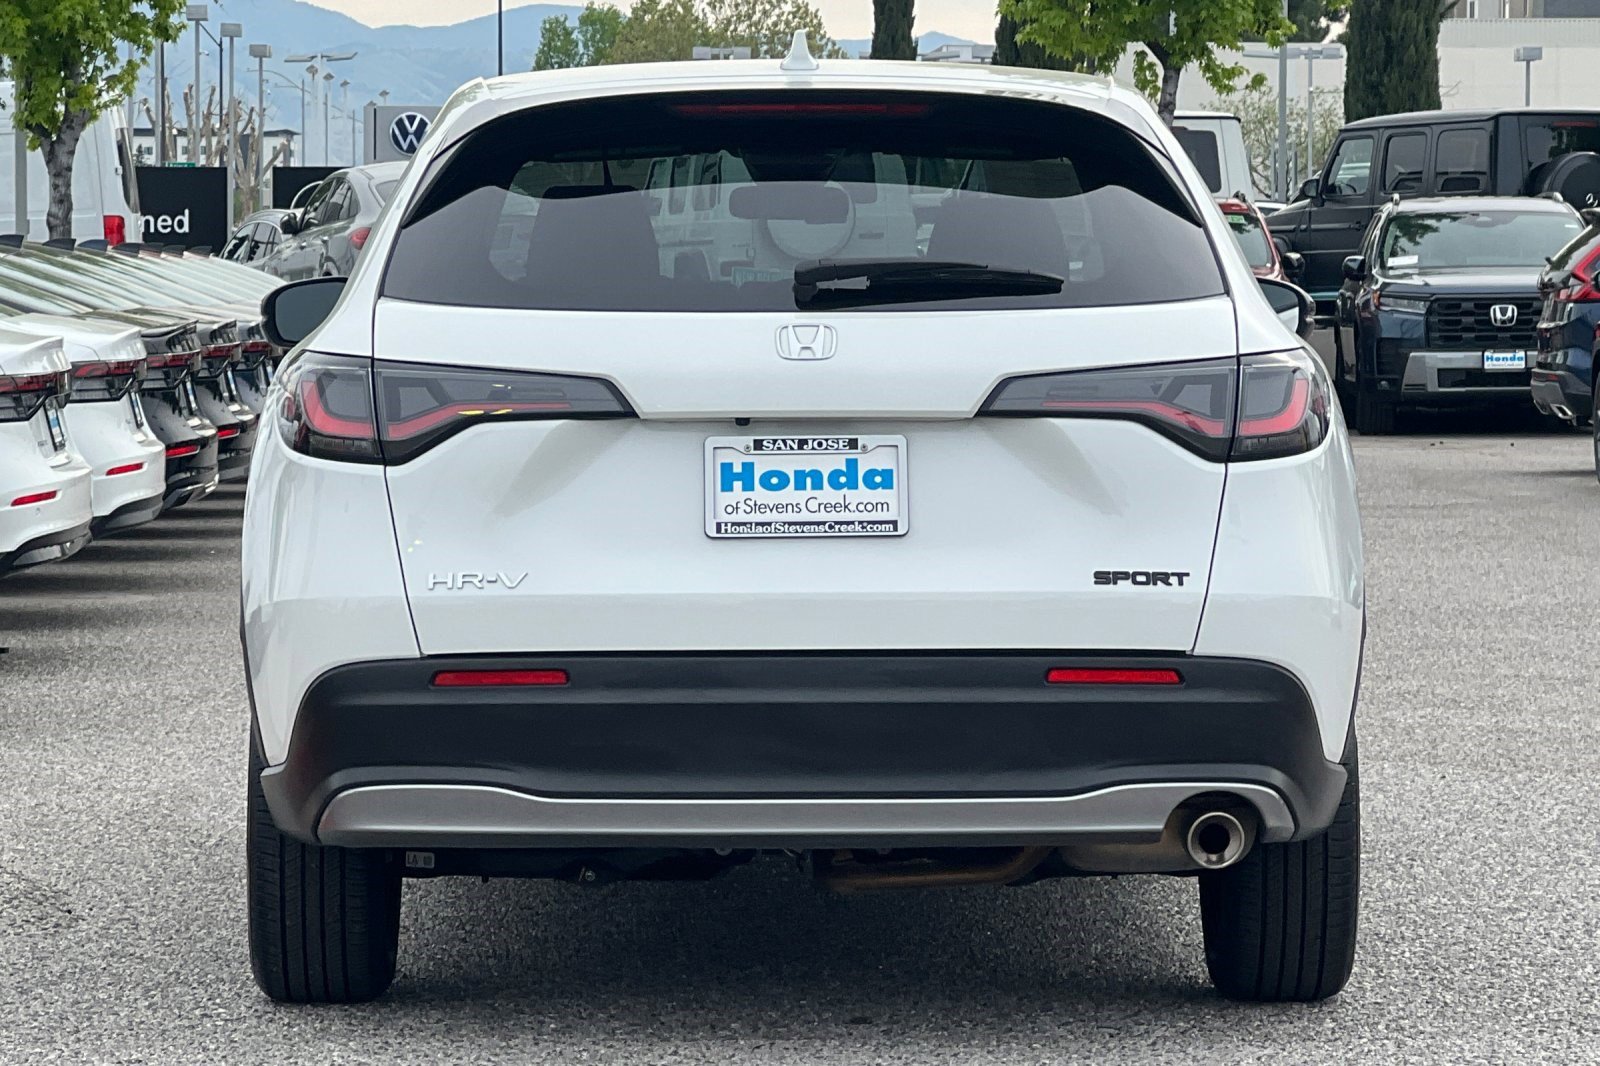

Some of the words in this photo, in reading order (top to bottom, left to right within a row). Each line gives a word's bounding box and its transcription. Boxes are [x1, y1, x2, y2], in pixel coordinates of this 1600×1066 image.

[1485, 353, 1524, 362] Honda
[762, 439, 799, 450] SAN
[803, 439, 850, 450] JOSE
[720, 458, 894, 492] Honda
[724, 501, 741, 515] of
[743, 498, 802, 515] Stevens
[805, 494, 890, 513] Creek.com
[720, 521, 894, 534] HondaofStevensCreek.com
[427, 571, 529, 590] HR-V
[1093, 570, 1190, 586] SPORT
